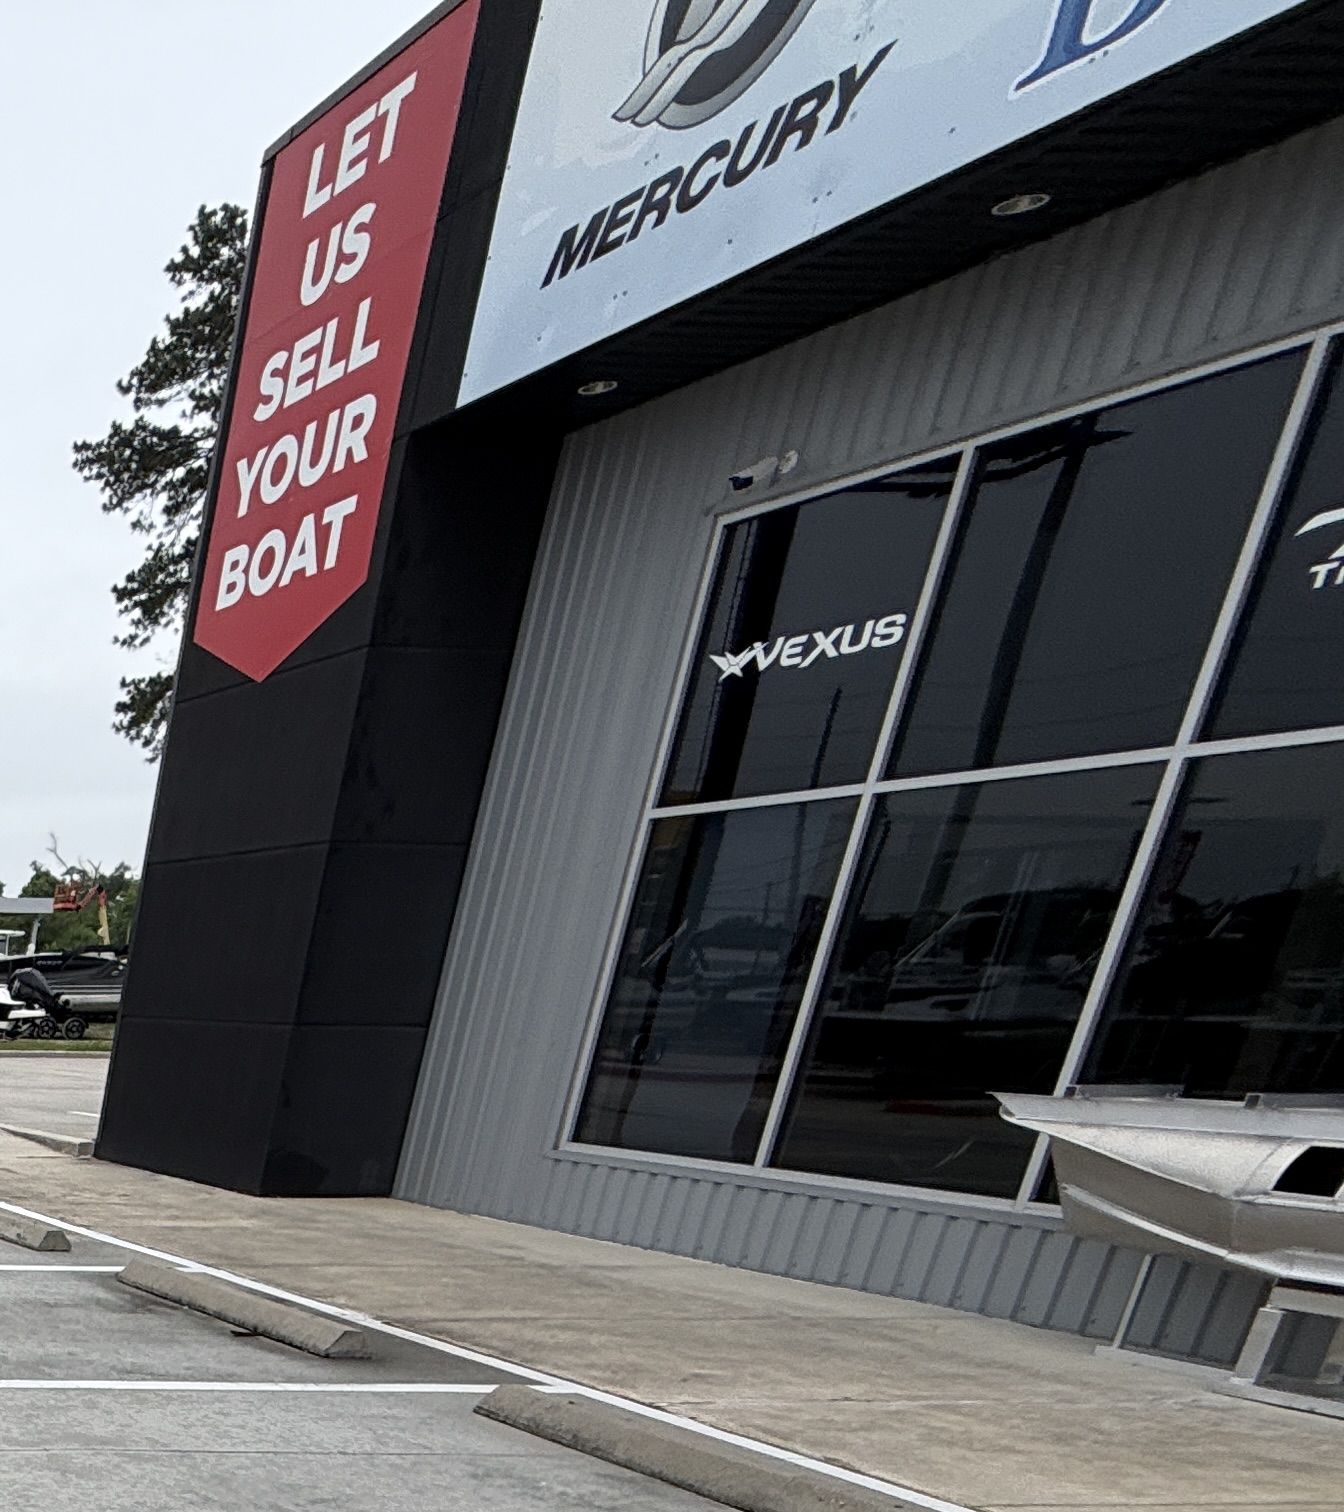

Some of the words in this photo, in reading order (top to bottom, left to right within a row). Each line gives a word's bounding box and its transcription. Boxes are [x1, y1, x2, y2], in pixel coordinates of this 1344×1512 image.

[302, 70, 418, 219] LET
[539, 39, 899, 289] MERCURY
[300, 202, 377, 307] US
[253, 296, 380, 422] SELL
[236, 393, 377, 518] YOUR
[215, 494, 359, 612] BOAT
[750, 613, 907, 672] VEXUS
